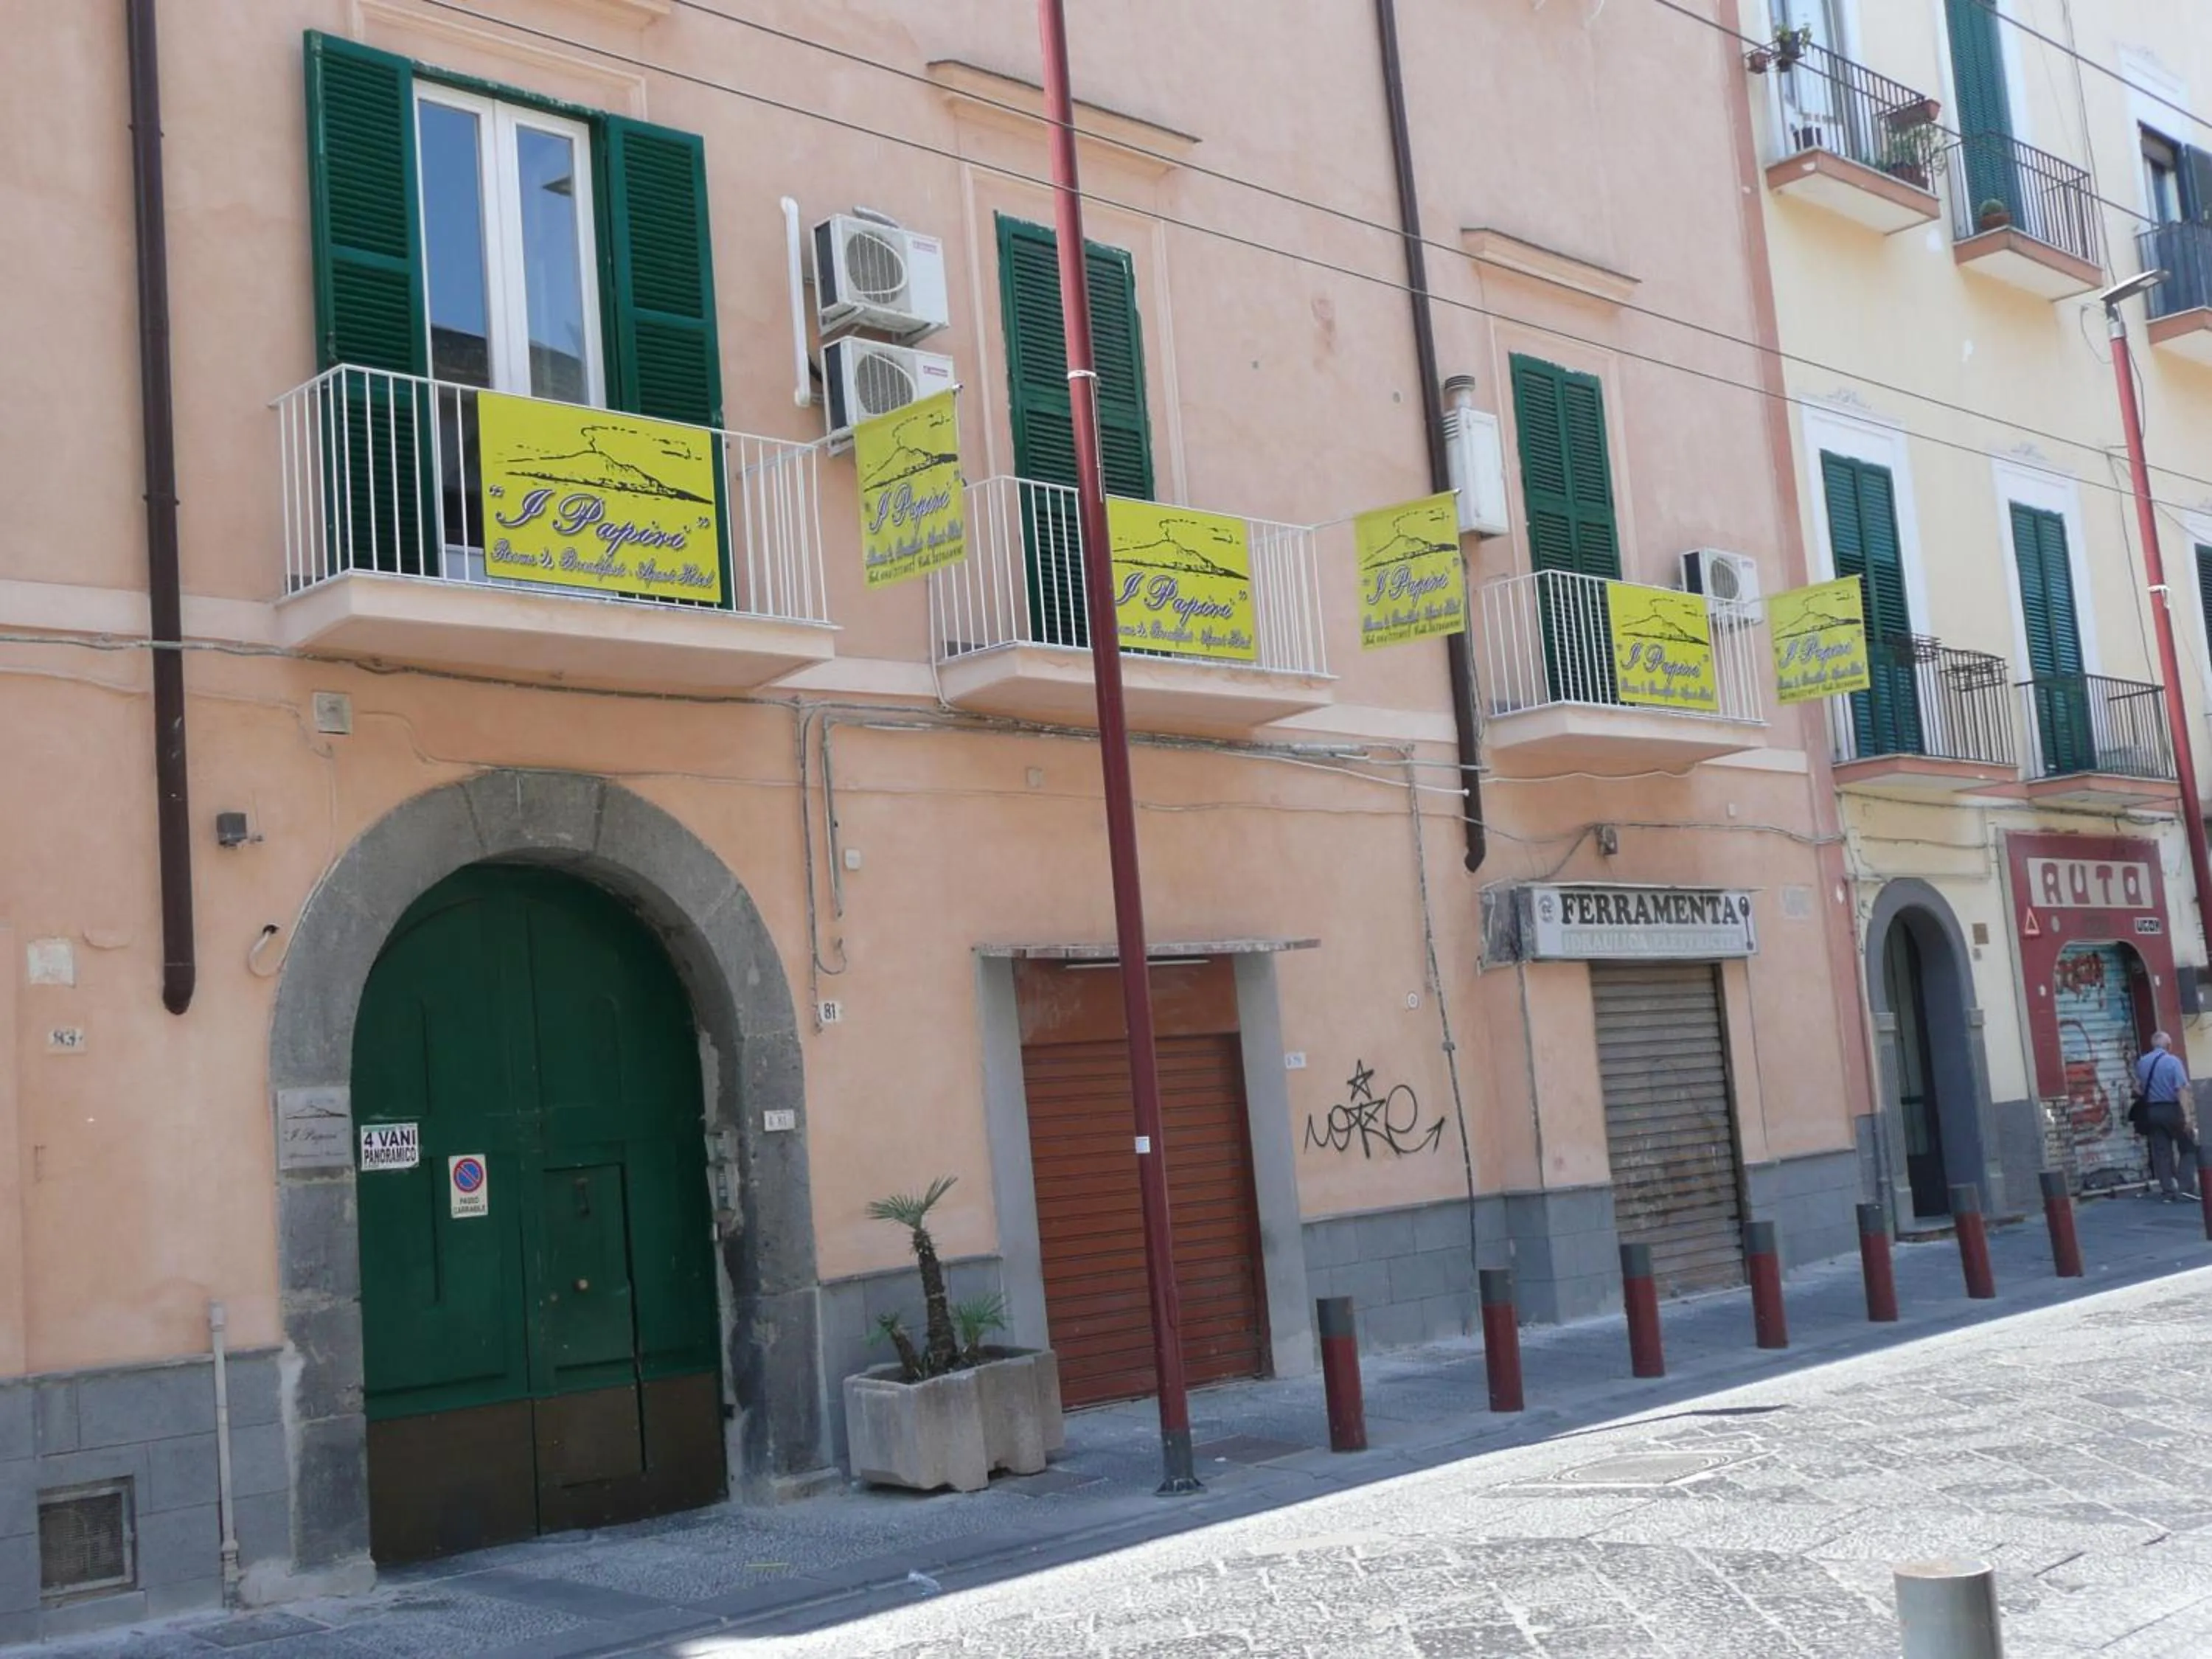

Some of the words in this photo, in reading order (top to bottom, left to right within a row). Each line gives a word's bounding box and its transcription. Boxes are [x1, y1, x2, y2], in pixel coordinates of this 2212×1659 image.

[2041, 862, 2143, 905] AUTO
[1559, 892, 1739, 925] FERRAMENTA
[824, 1002, 836, 1020] 81
[364, 1132, 374, 1147] 4
[378, 1129, 417, 1147] VANI
[364, 1147, 417, 1164] PANORAMICO
